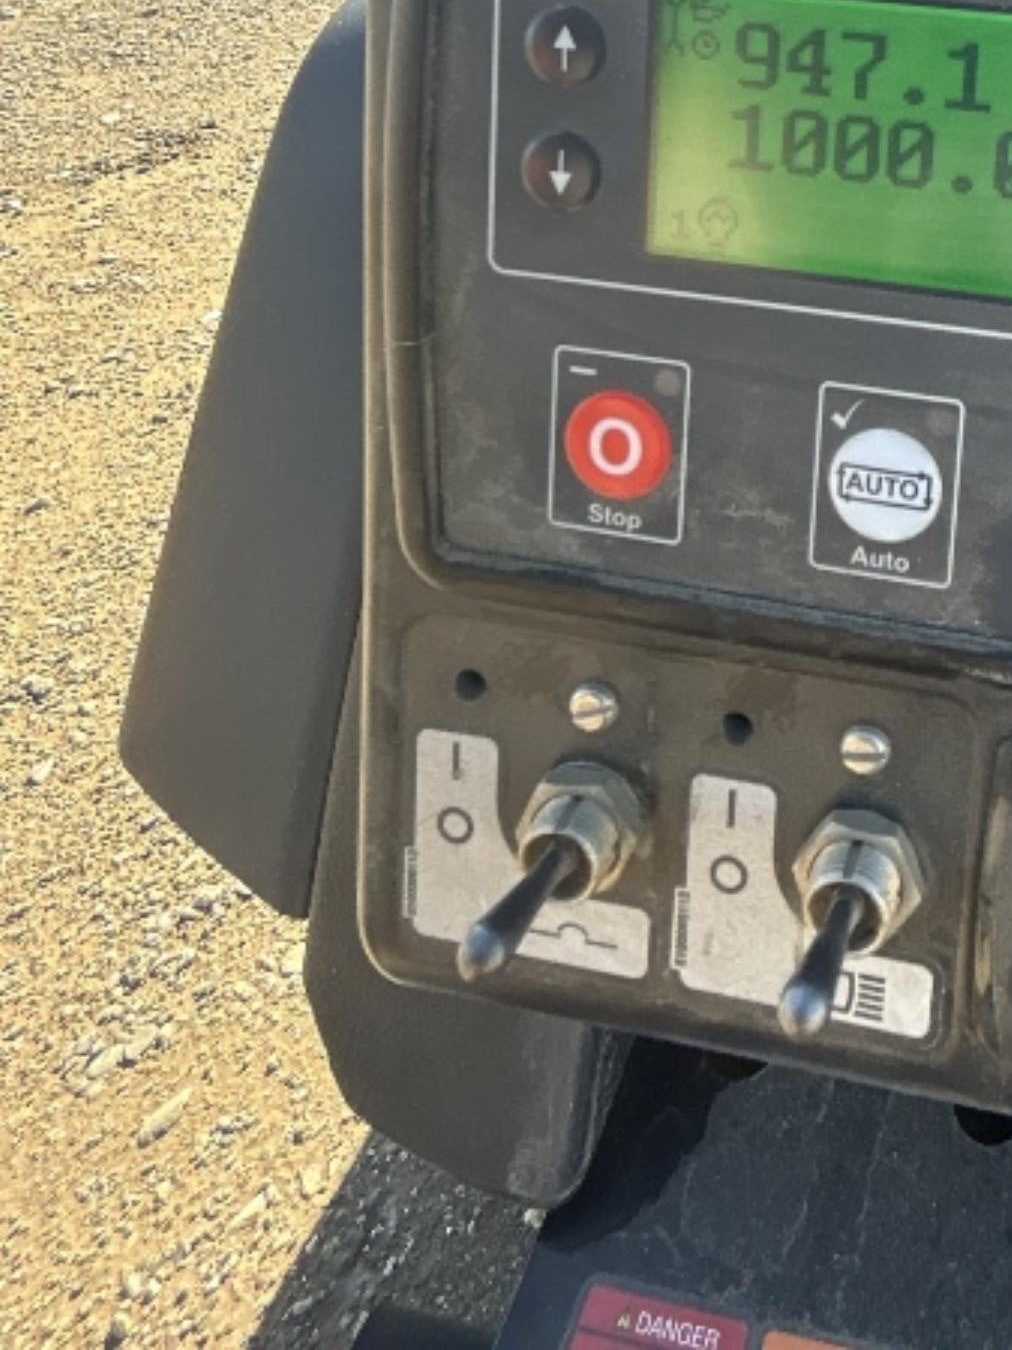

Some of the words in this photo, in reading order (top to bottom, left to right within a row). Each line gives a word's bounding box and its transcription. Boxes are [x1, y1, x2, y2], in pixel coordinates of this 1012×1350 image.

[735, 21, 992, 114] 947.1
[845, 471, 919, 501] AUTO
[586, 503, 643, 532] Stop
[850, 544, 911, 574] Auto
[635, 1310, 721, 1350] DANGER
